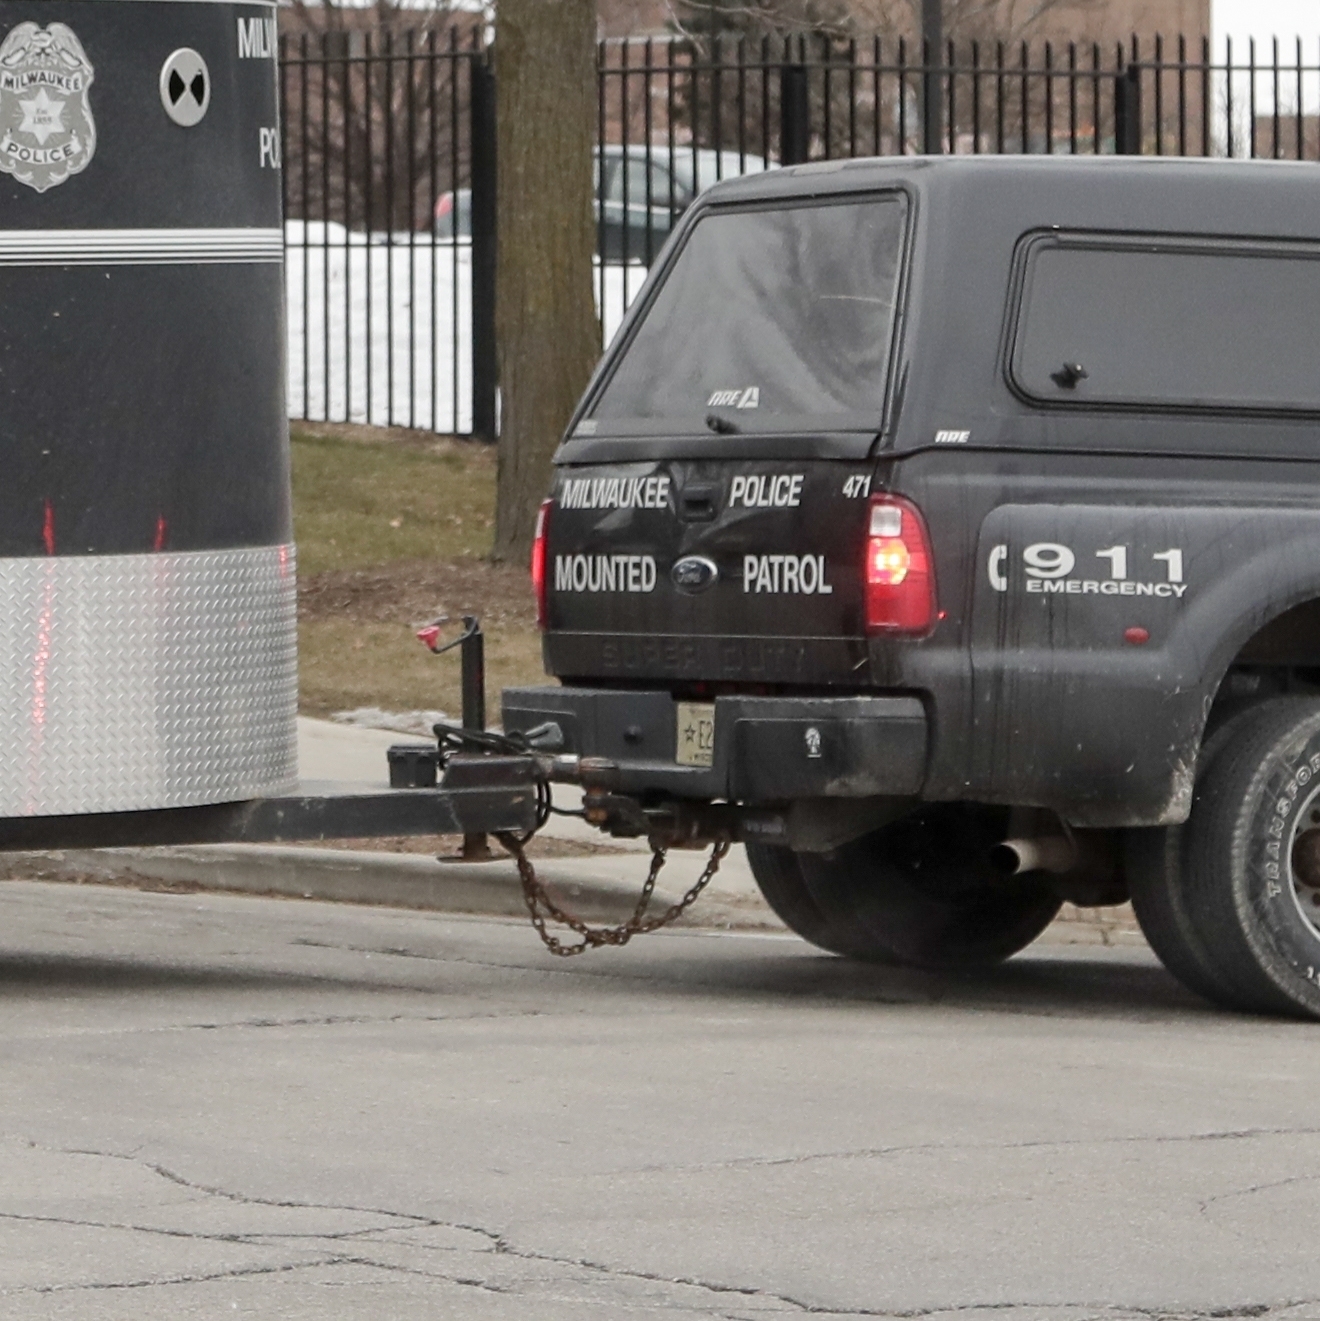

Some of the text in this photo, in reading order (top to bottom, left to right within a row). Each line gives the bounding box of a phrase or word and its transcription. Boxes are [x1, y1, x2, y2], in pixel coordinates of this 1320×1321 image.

[3, 72, 80, 90] MILWAUKEE
[7, 143, 74, 163] POLICE
[560, 475, 804, 509] MILWAUKEE POLICE
[842, 475, 872, 499] 471
[555, 554, 833, 595] MOUNTED PATROL
[1023, 543, 1183, 583] 911
[1026, 580, 1187, 598] EMERGENCY
[602, 642, 806, 674] SUPER DUTY
